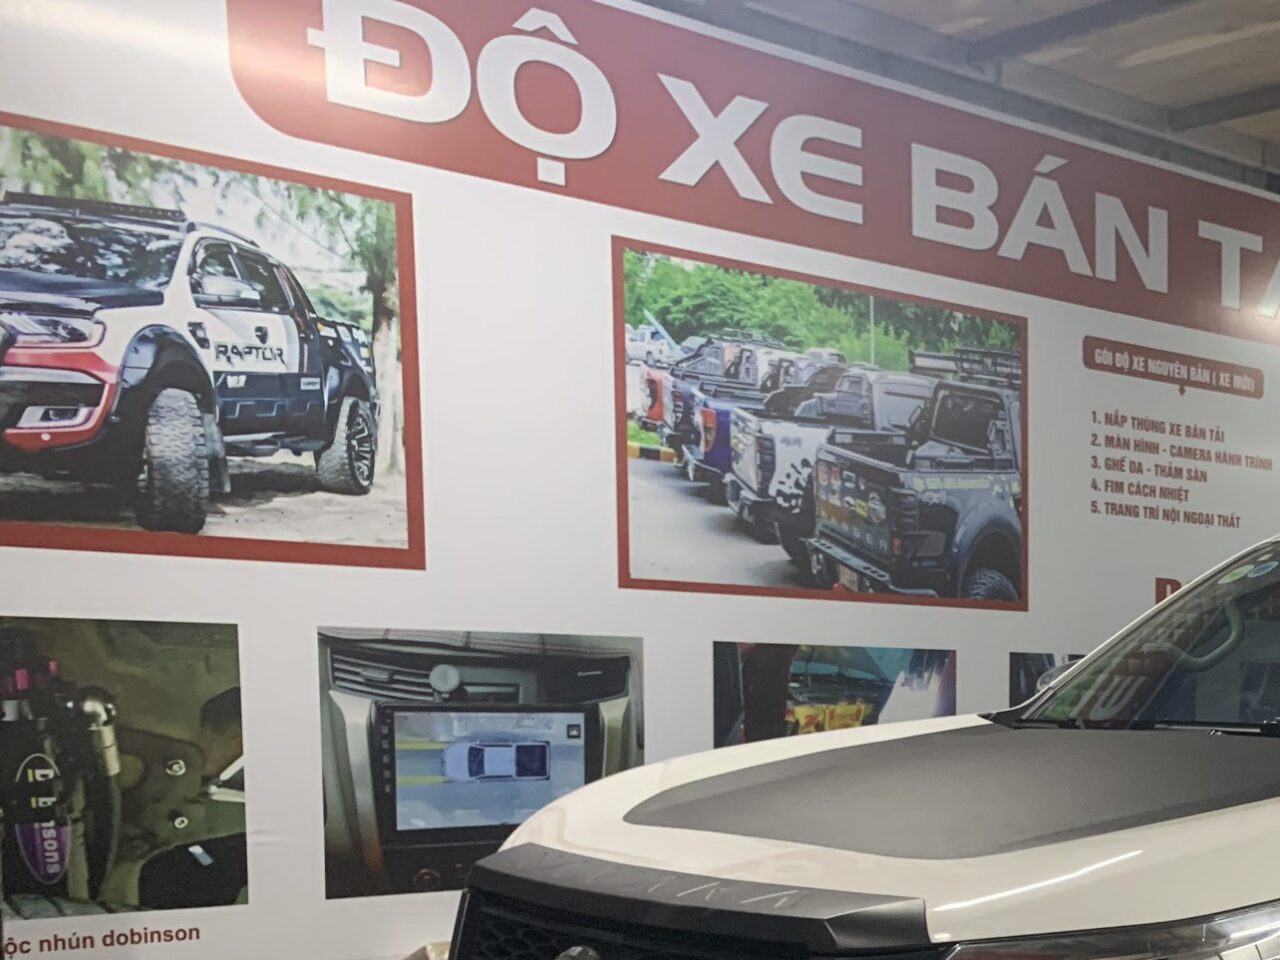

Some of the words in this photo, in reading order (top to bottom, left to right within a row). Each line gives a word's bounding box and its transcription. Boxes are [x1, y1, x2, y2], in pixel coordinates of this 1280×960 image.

[307, 0, 617, 186] ĐỘ
[657, 73, 863, 224] XE
[911, 142, 1168, 293] BÁN
[215, 345, 287, 367] RAPTOR
[1132, 355, 1145, 371] XE
[1219, 373, 1231, 388] XE
[1091, 410, 1102, 425] 1.
[1131, 416, 1166, 435] THÙNG
[1169, 423, 1182, 437] XE
[1185, 422, 1206, 441] BÁN
[1091, 433, 1102, 447] 2.
[1104, 433, 1131, 451] MÀN
[1133, 436, 1160, 455] HÌNH
[1169, 444, 1212, 463] CAMERA
[1091, 456, 1102, 470] 3.
[1104, 455, 1126, 474] GHẾ
[1129, 461, 1144, 475] DA
[1091, 478, 1102, 492] 4.
[1127, 480, 1157, 499] CÁCH
[1091, 501, 1102, 514] 5.
[1104, 502, 1140, 518] TRANG
[38, 931, 95, 953] nhún
[101, 927, 201, 948] dobinson
